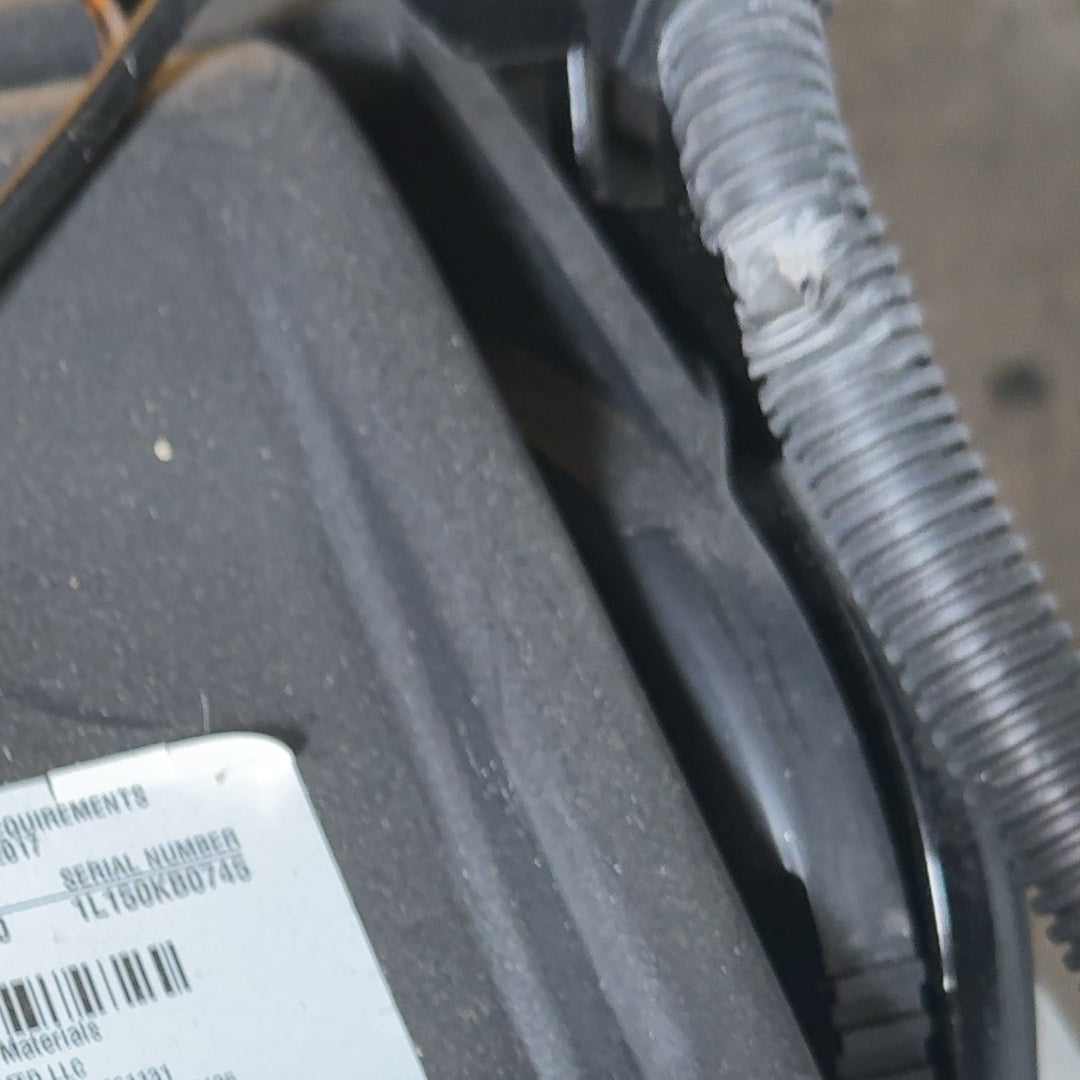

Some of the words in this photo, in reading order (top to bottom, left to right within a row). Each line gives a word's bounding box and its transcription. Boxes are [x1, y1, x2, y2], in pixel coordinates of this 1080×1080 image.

[59, 852, 139, 891] SERIAL
[143, 826, 242, 870] NUMBER
[0, 1019, 103, 1065] Materials
